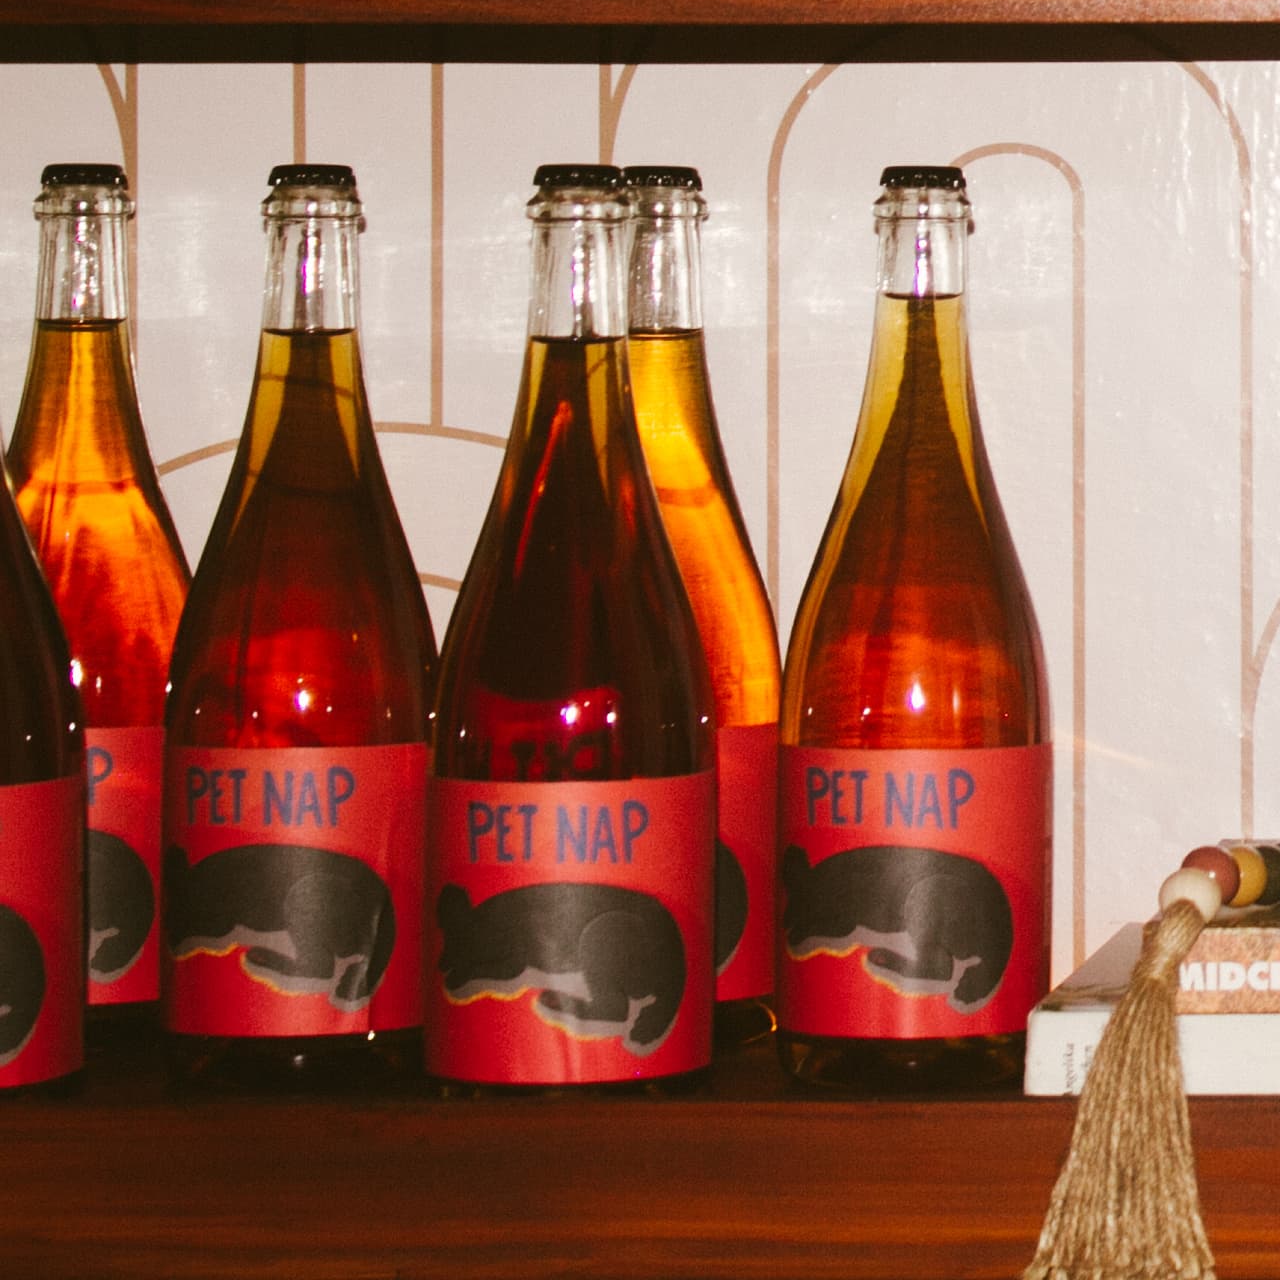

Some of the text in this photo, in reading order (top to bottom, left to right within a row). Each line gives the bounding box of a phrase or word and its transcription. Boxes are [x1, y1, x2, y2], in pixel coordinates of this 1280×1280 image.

[185, 765, 247, 825] PET
[262, 765, 356, 829] NAP
[805, 766, 976, 830] PET NAP
[466, 799, 650, 865] PET NAP
